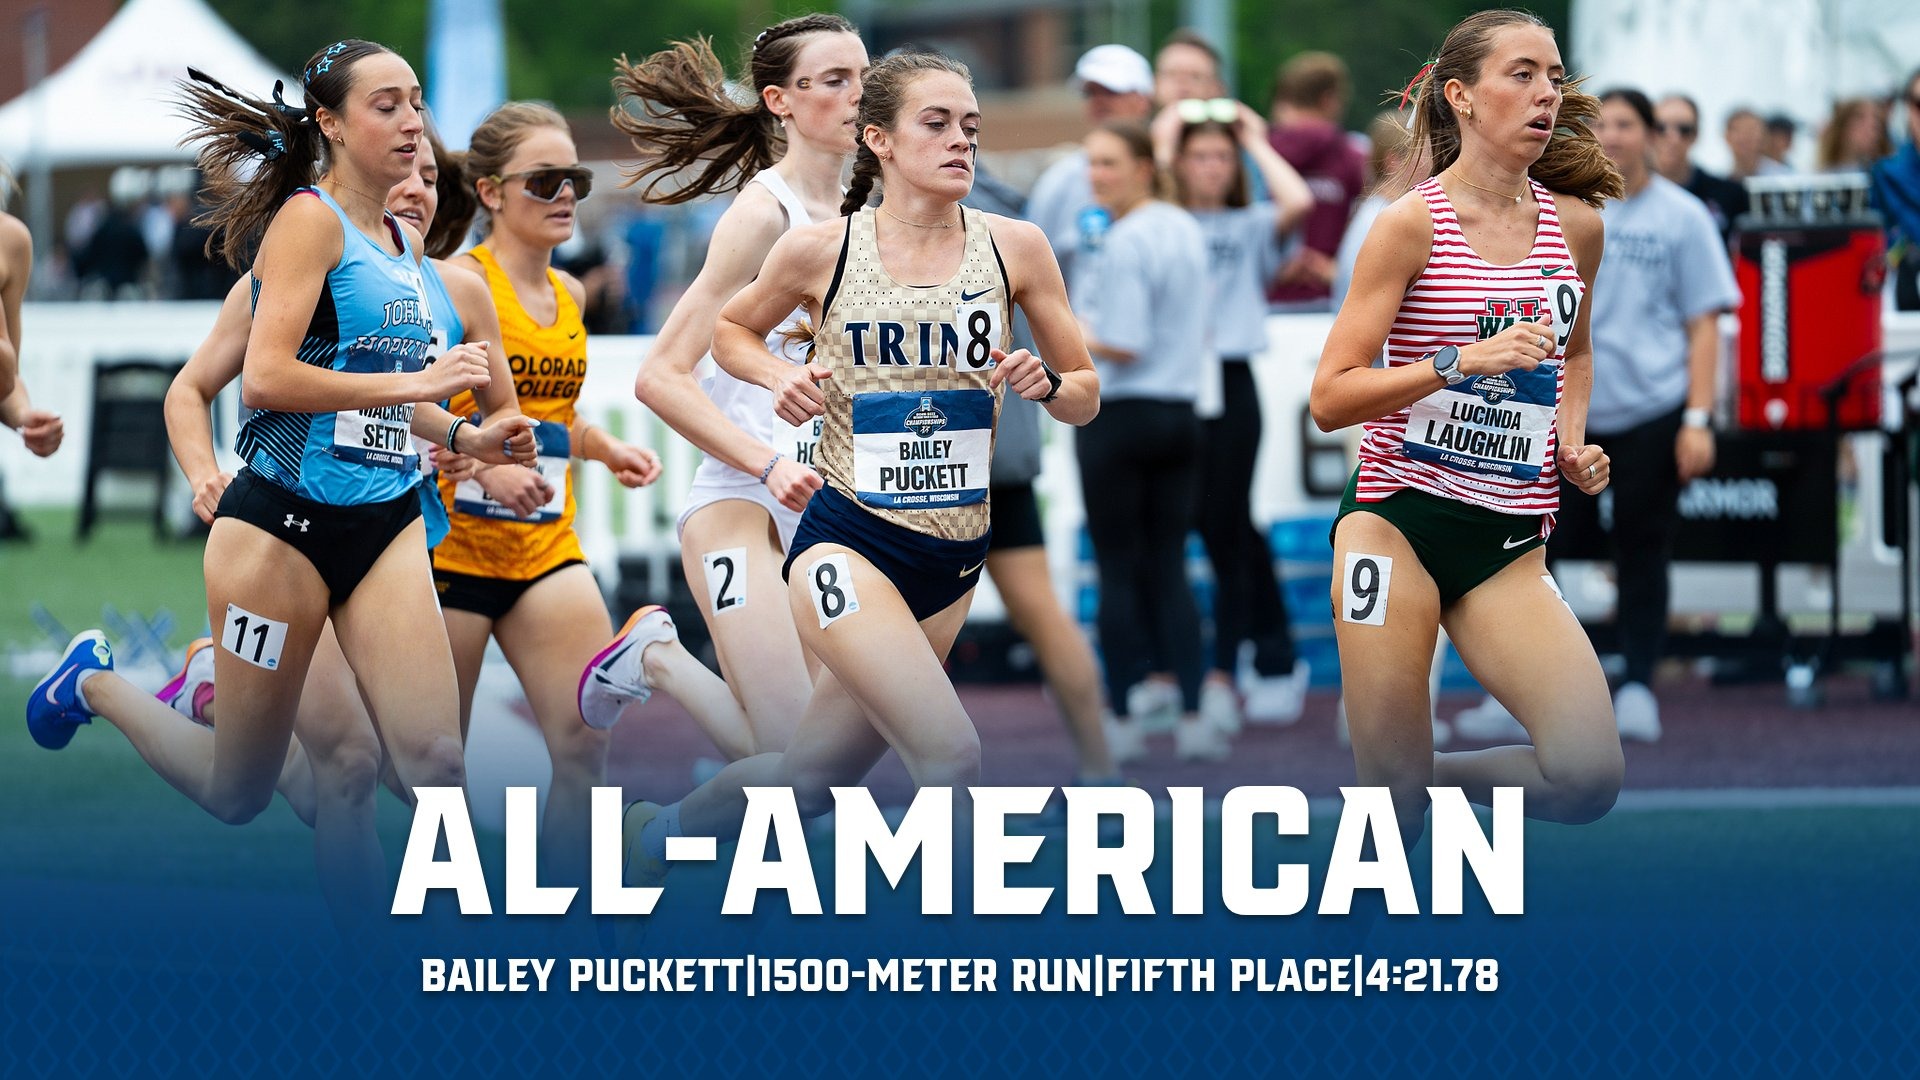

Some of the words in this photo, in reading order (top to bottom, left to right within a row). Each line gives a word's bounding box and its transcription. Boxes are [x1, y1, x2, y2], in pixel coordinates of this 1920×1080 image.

[1556, 283, 1577, 347] 9
[967, 309, 991, 368] 8
[507, 354, 587, 377] OLORAD
[1450, 401, 1521, 431] LUCINDA
[899, 440, 953, 460] BAILEY
[1424, 420, 1532, 463] LAUGHLIN
[1440, 453, 1449, 461] LA
[1449, 456, 1476, 468] CROSSE,
[1477, 461, 1513, 473] WISCONSIN
[880, 463, 968, 491] PUCKETT
[893, 496, 902, 504] LA
[902, 495, 929, 504] CROSSE,
[929, 493, 960, 503] WISCONSIN
[712, 556, 735, 611] 2
[815, 562, 846, 618] 8
[1350, 558, 1380, 621] 9
[234, 615, 270, 663] 11
